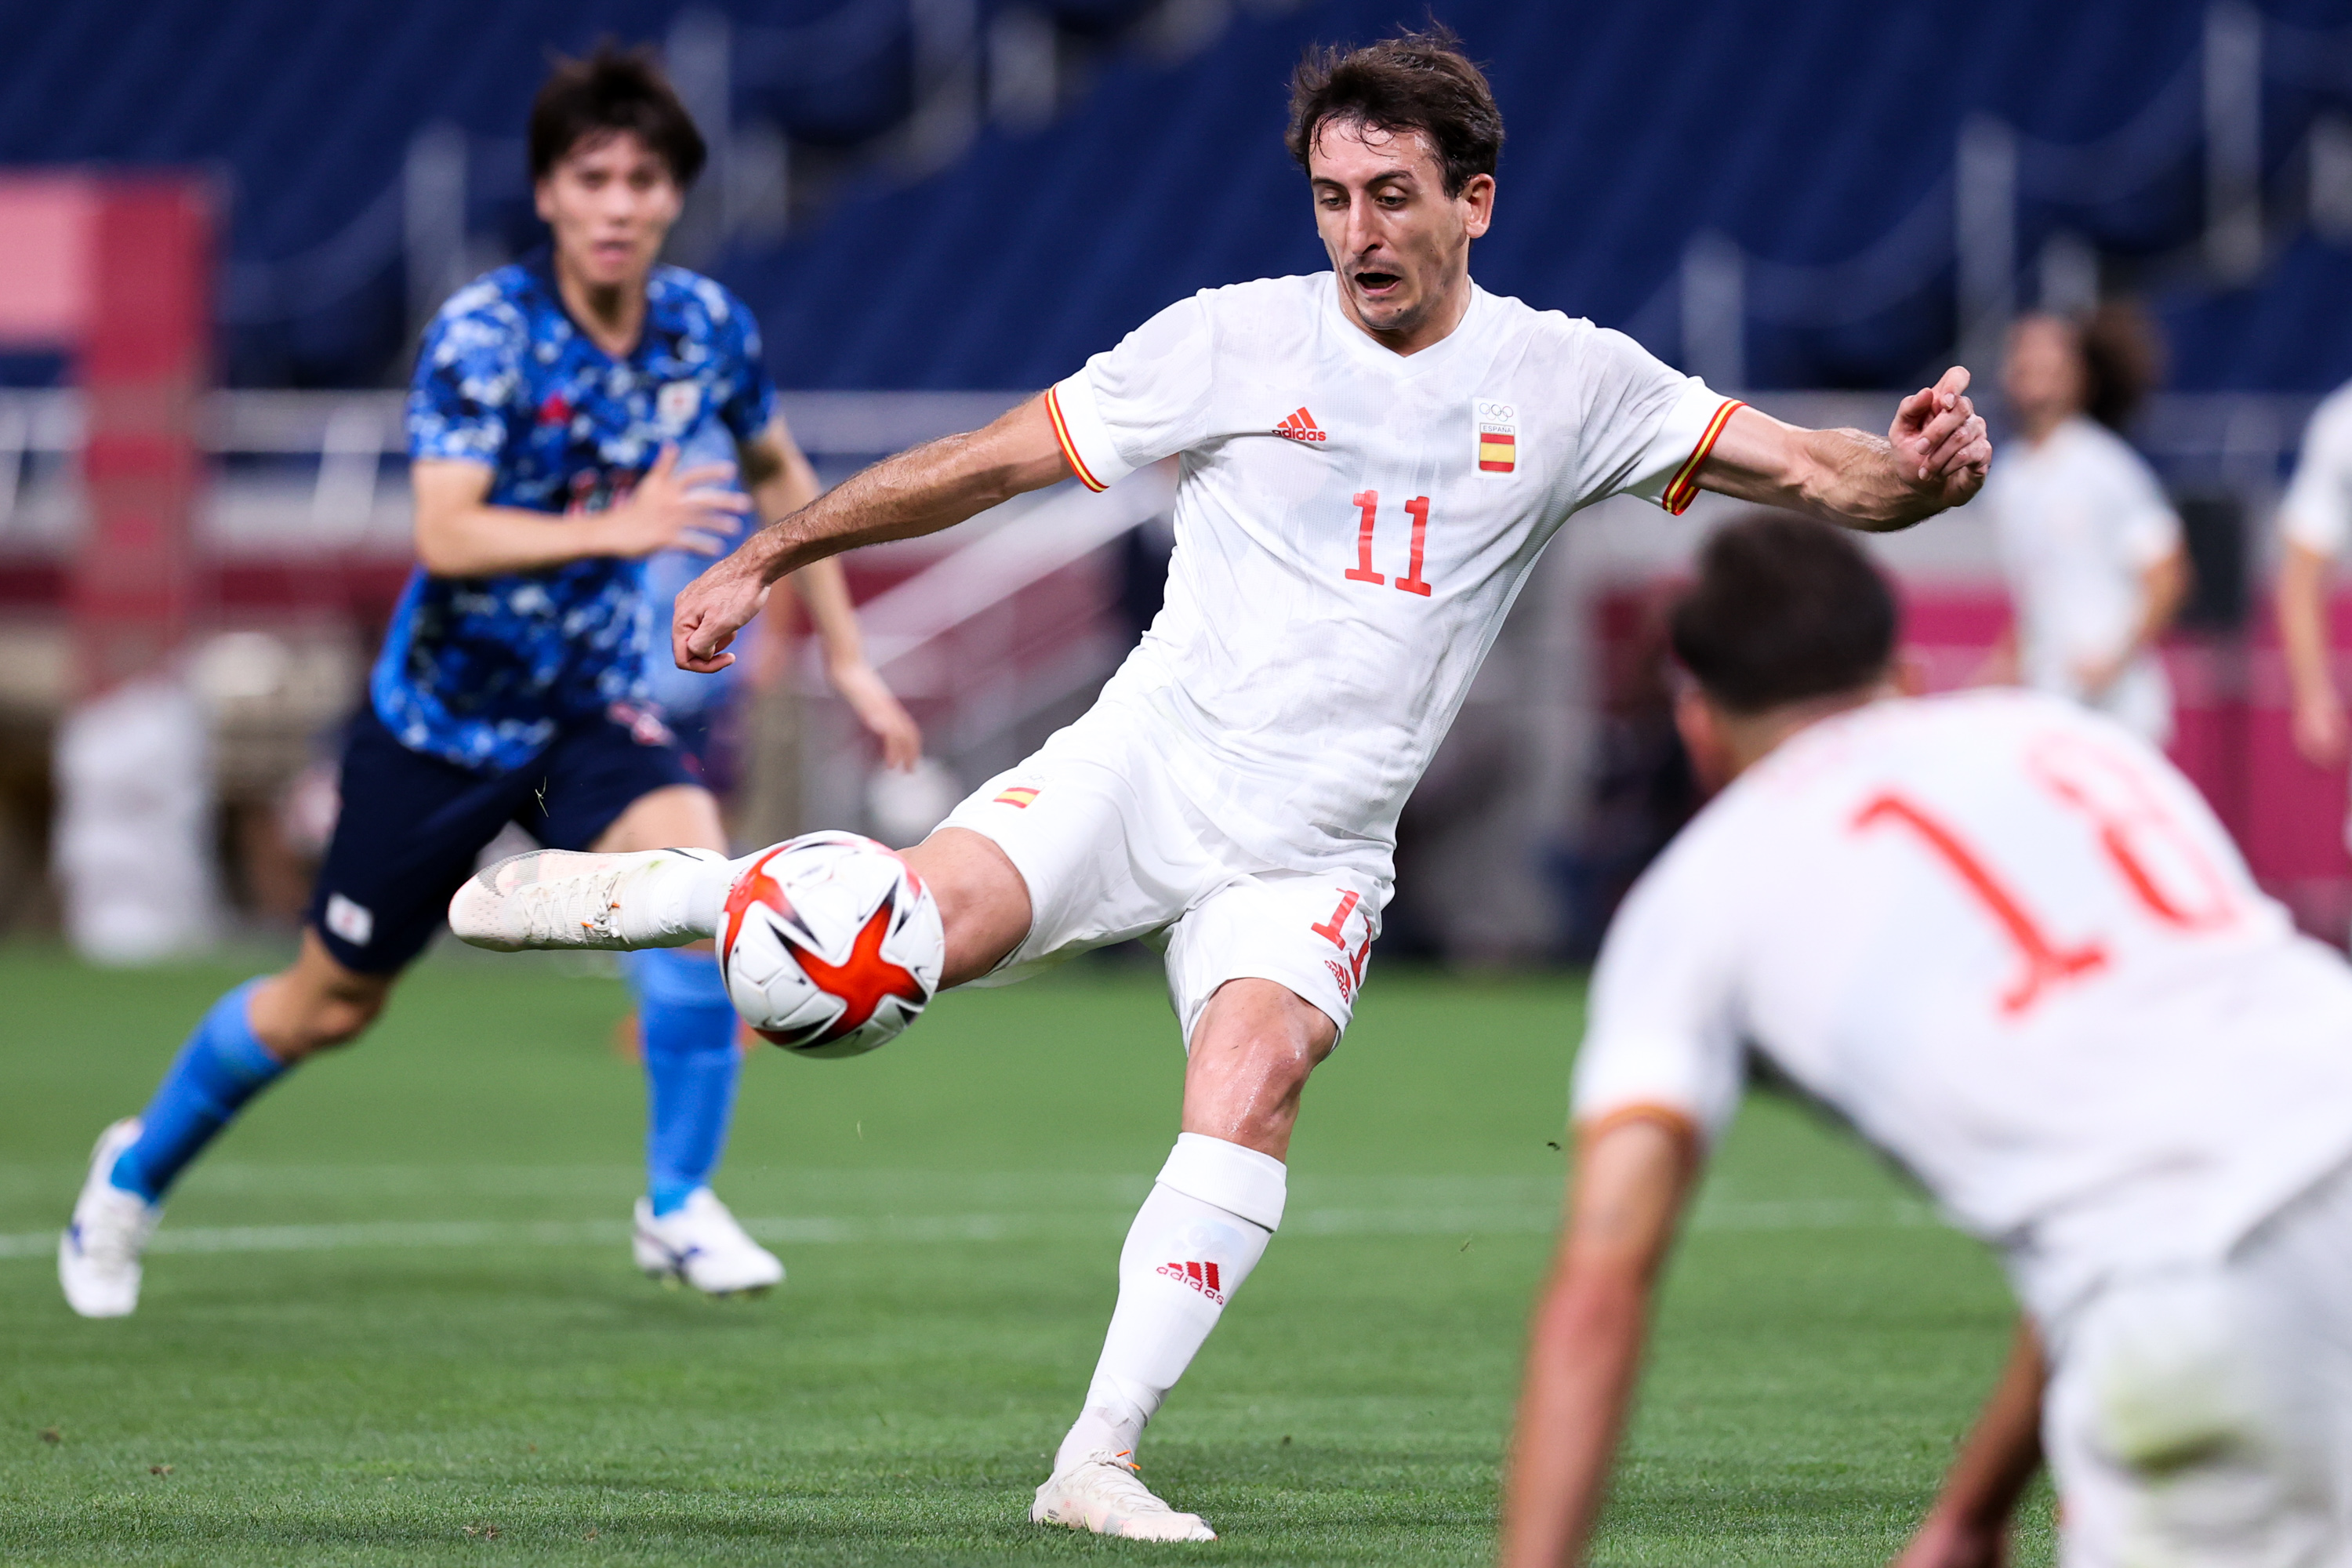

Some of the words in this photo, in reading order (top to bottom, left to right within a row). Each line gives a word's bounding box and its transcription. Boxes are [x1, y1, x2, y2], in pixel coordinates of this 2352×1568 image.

[1272, 427, 1327, 441] adidas
[1483, 425, 1512, 434] ESPAÑA
[1345, 489, 1432, 597] 11
[1846, 729, 2238, 1019] 18
[1156, 1266, 1224, 1305] adidas
